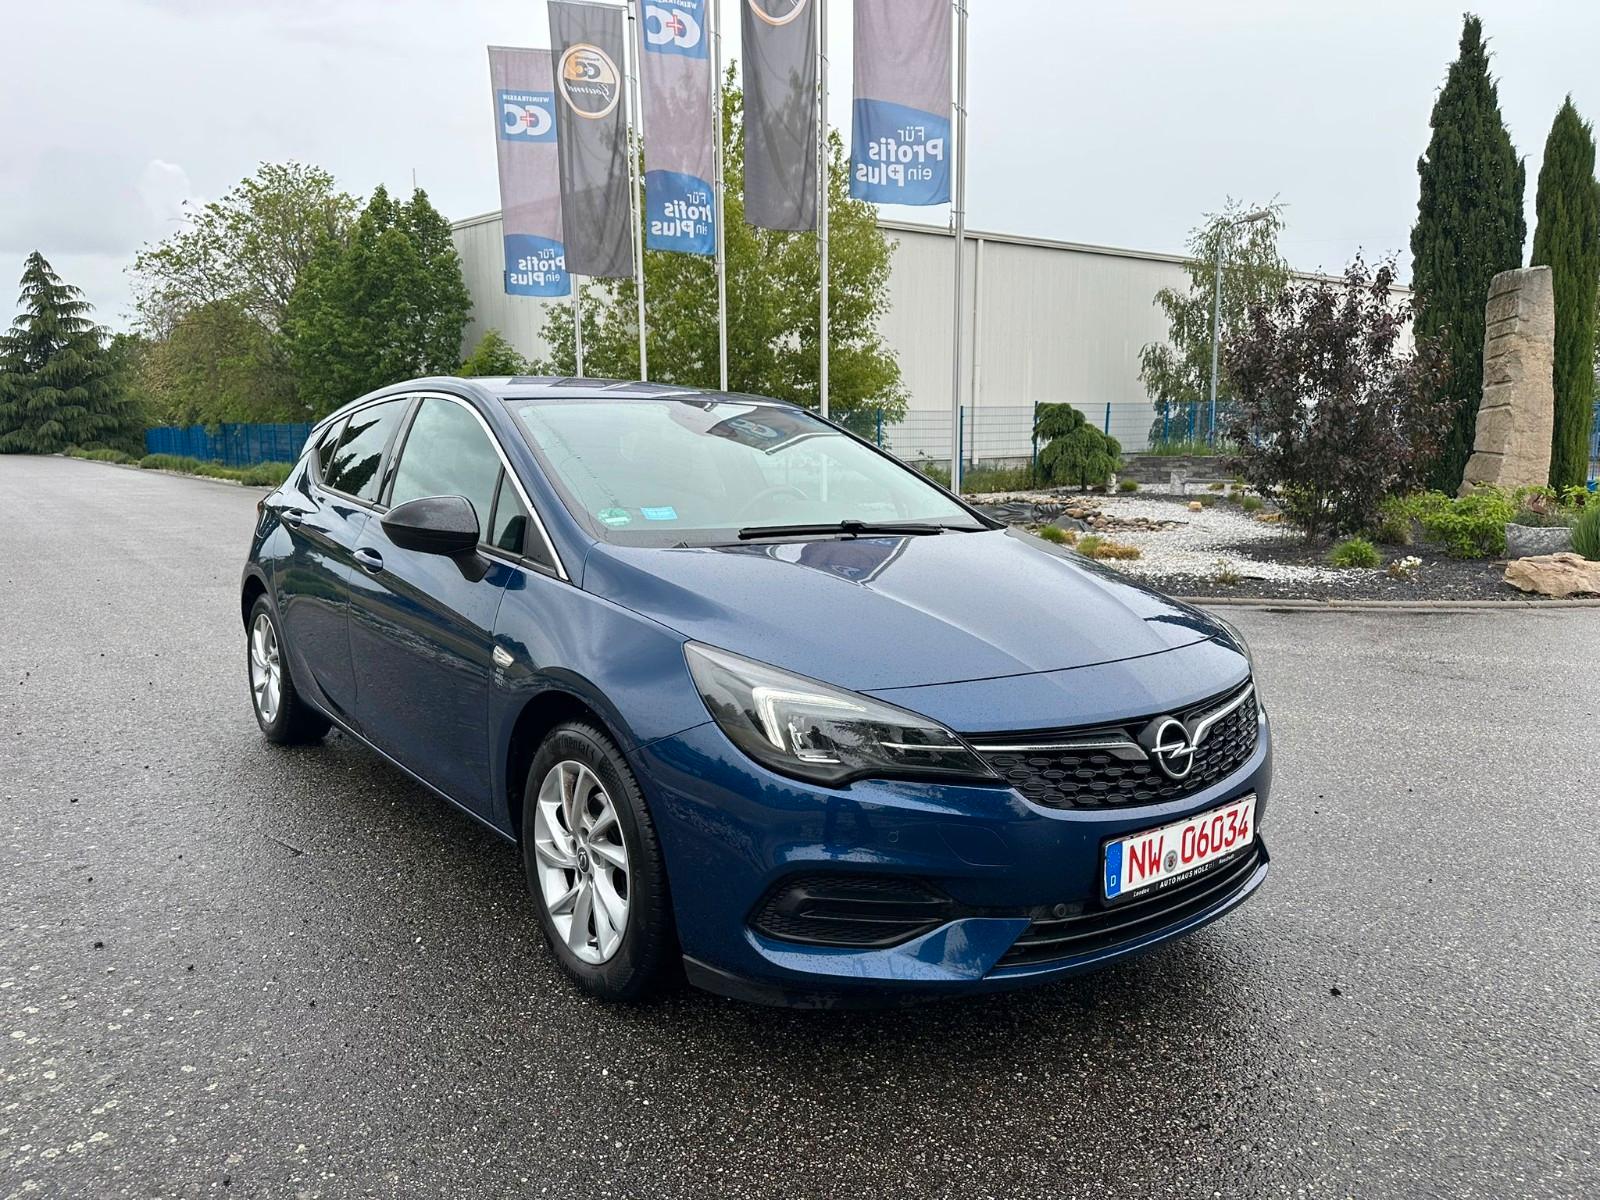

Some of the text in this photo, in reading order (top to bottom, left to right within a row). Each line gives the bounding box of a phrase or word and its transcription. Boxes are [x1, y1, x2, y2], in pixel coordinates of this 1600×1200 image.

[1128, 805, 1250, 883] NW 06034
[1193, 864, 1209, 877] HOLZ
[1110, 874, 1116, 887] D
